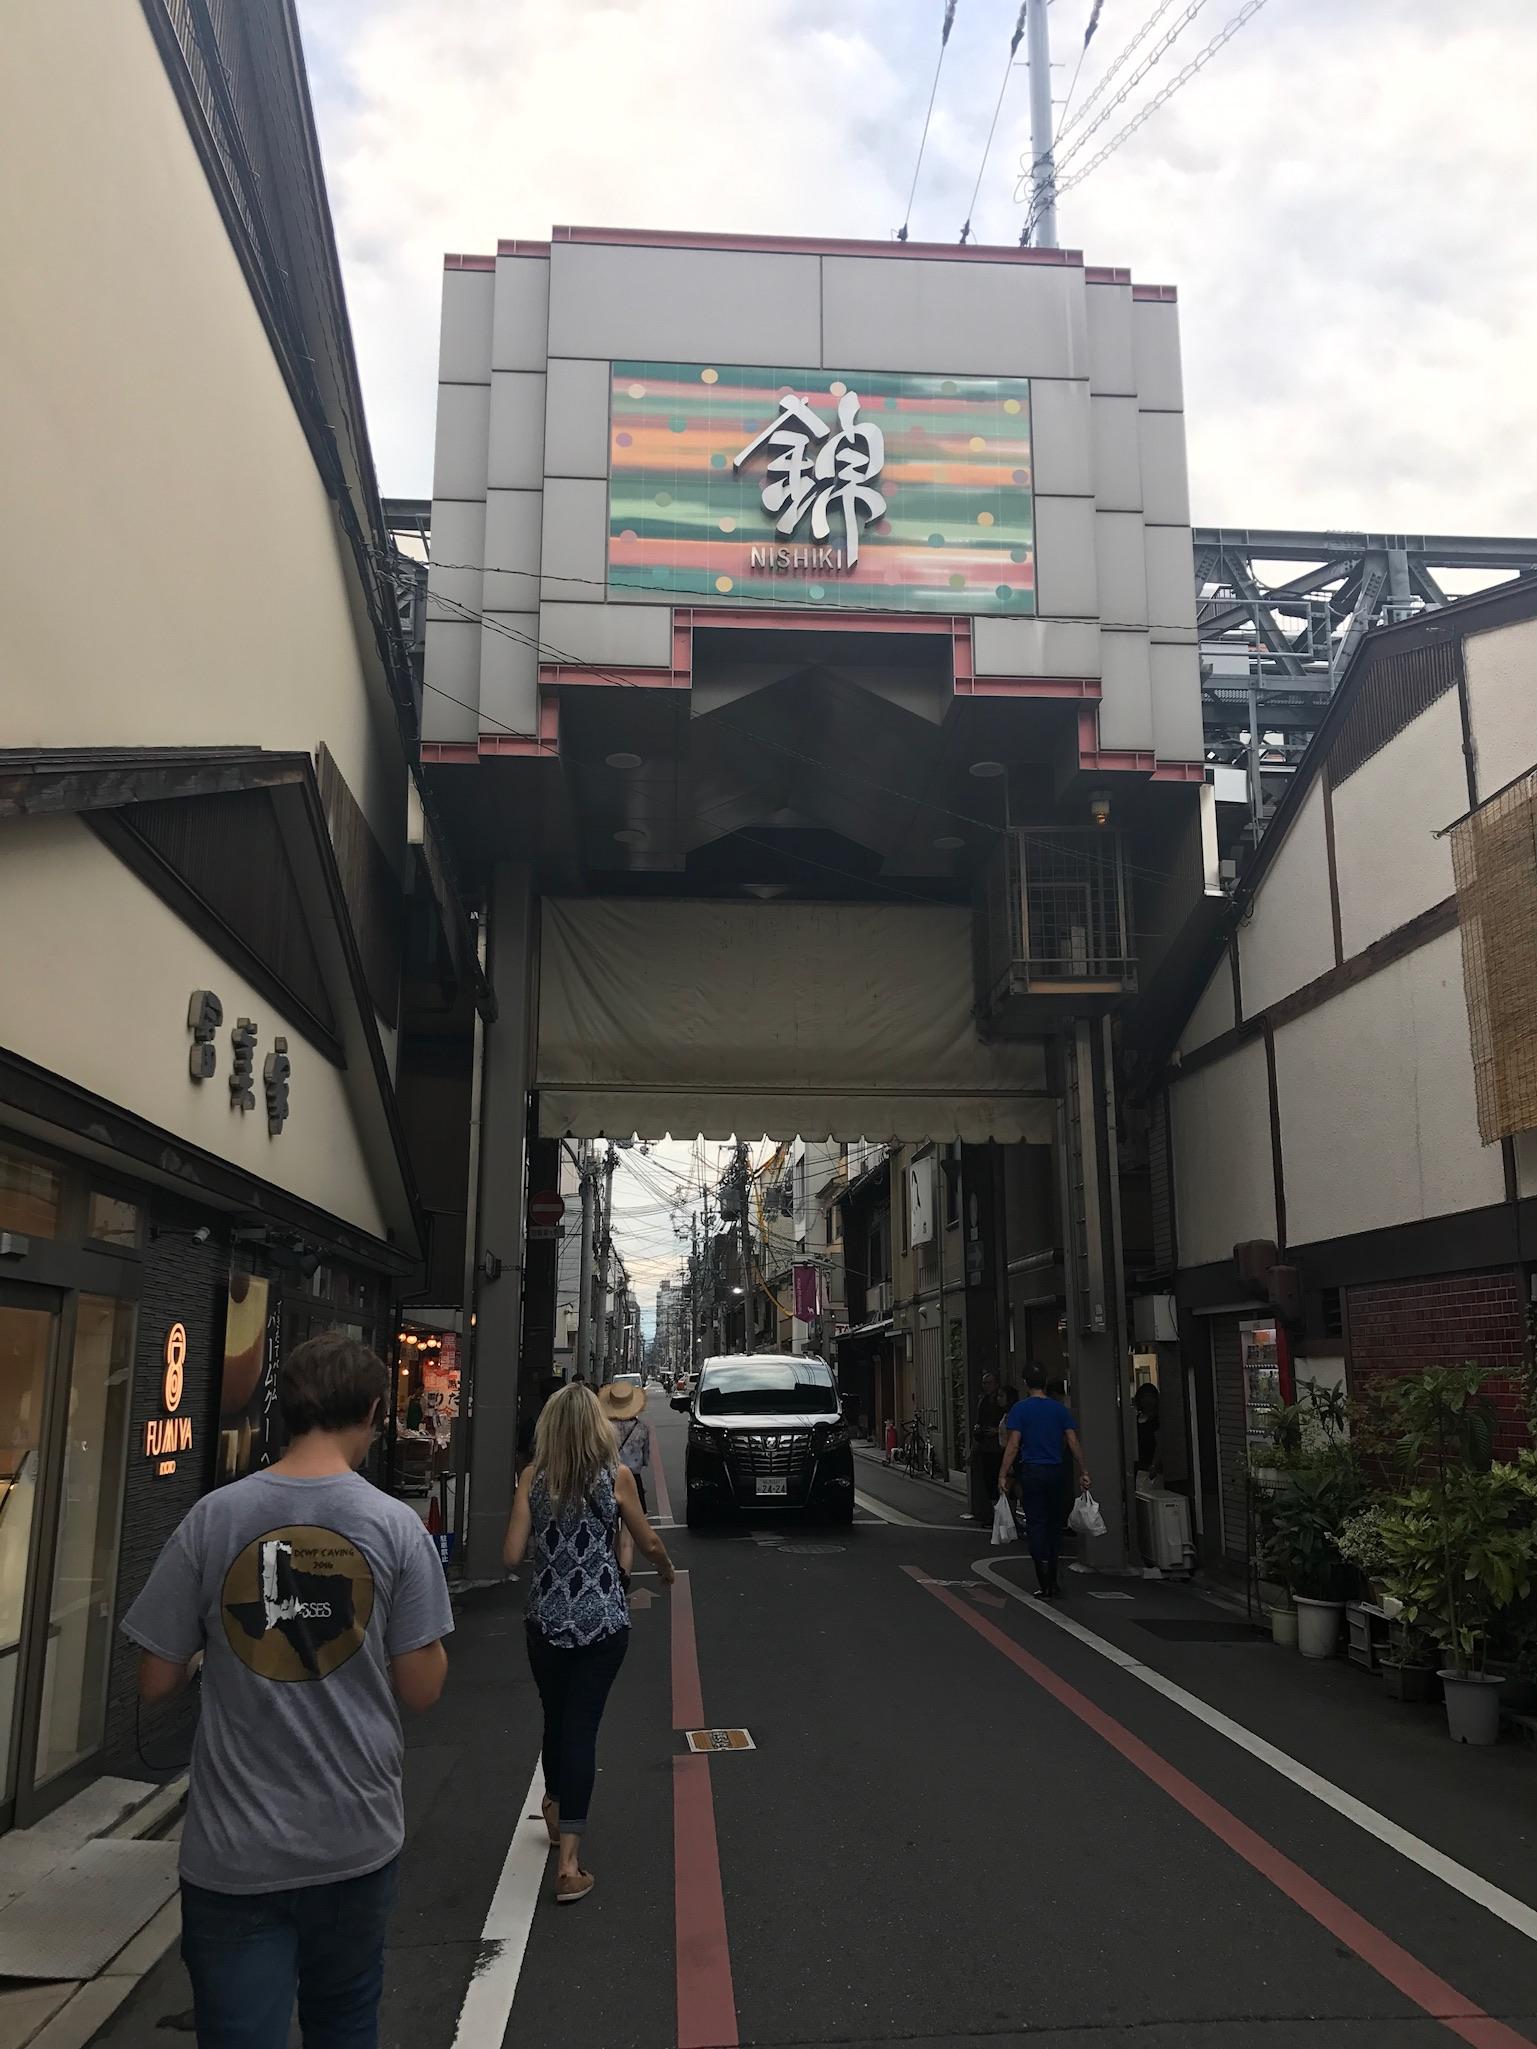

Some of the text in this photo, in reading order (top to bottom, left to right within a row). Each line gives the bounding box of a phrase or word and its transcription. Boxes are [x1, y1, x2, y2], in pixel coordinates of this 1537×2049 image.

[733, 390, 887, 569] 錦
[750, 546, 842, 571] NISHIKI
[146, 1417, 192, 1457] FUMIYA
[320, 1547, 355, 1557] CAVING
